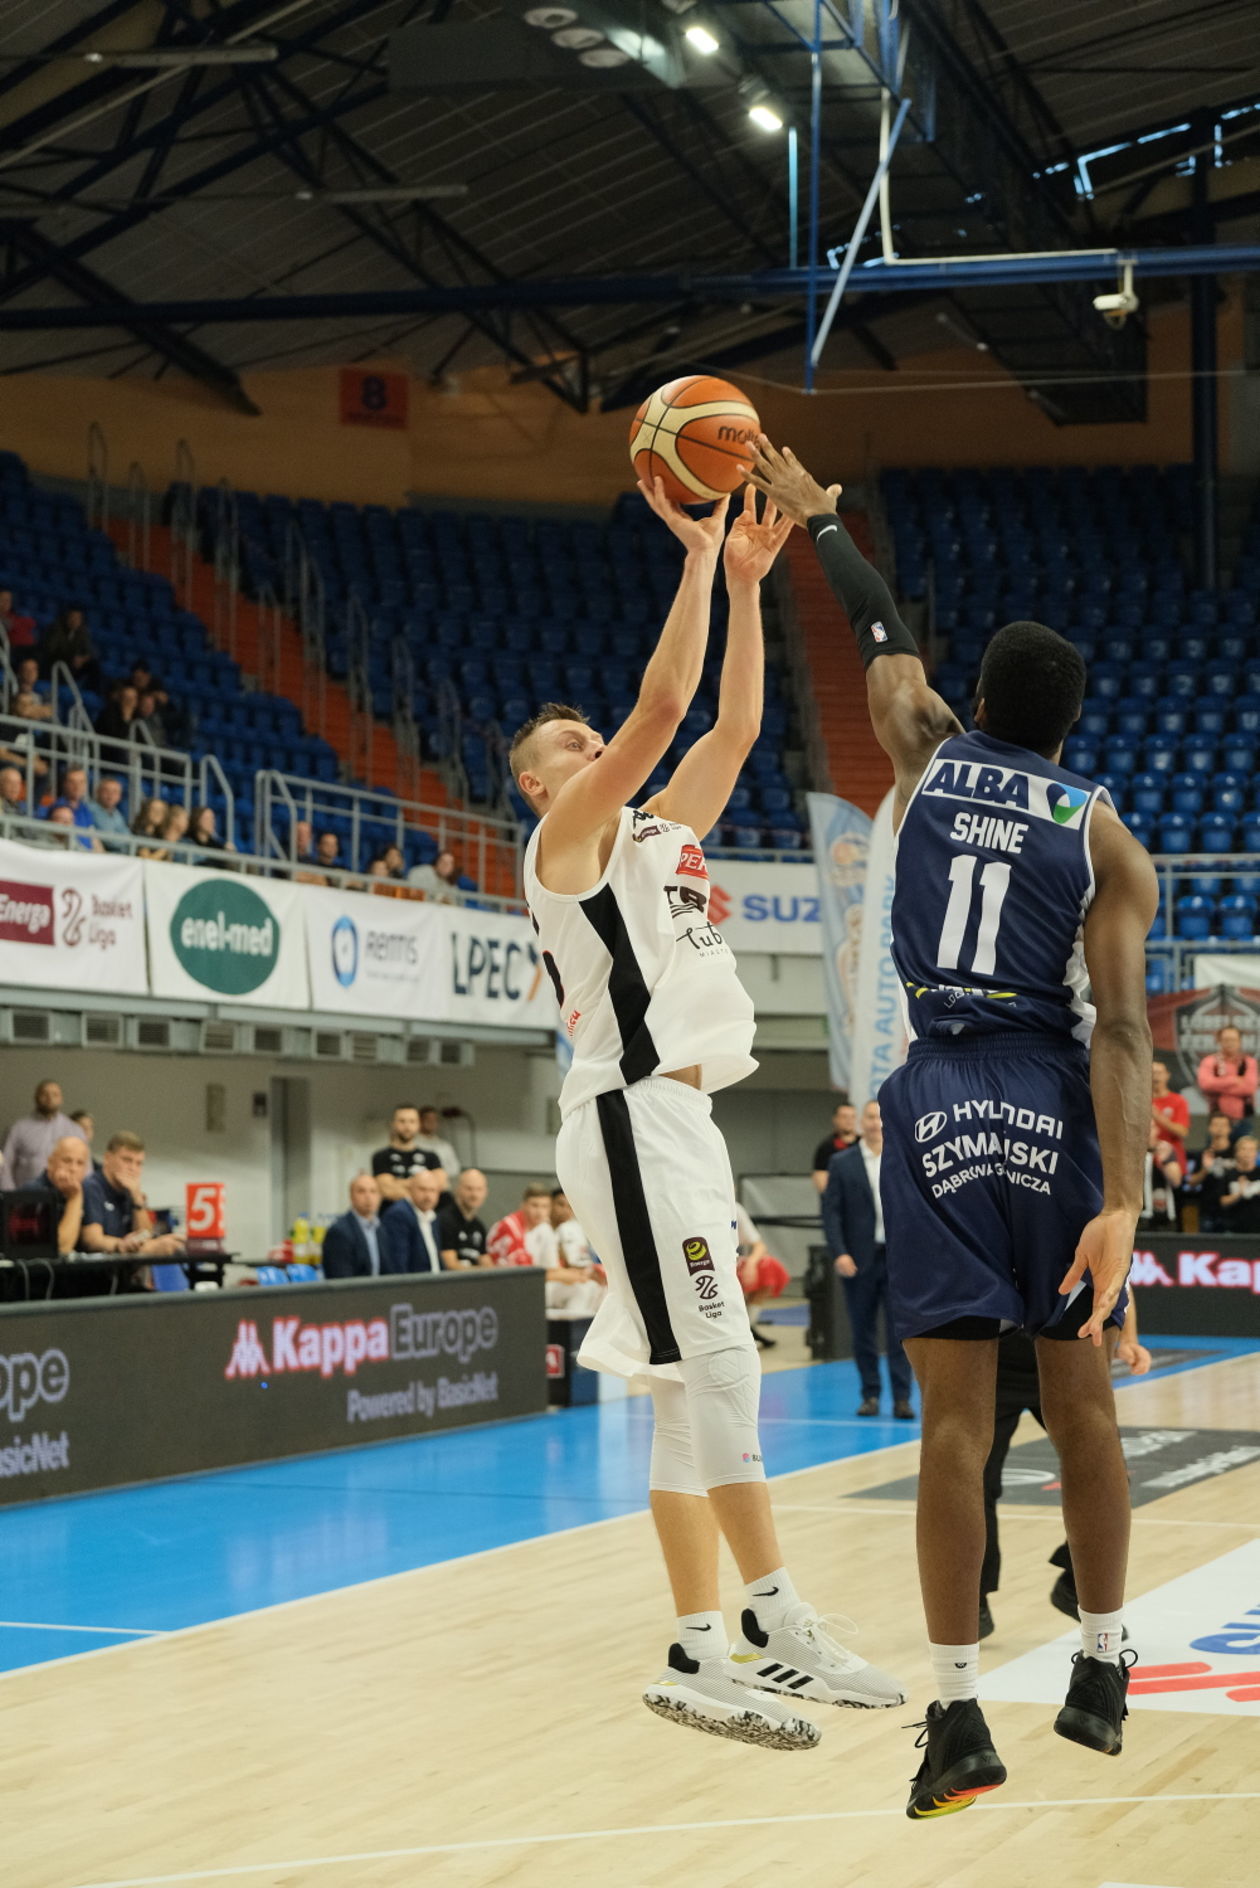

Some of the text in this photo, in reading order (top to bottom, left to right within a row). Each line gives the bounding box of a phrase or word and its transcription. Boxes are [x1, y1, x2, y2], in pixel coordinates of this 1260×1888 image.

[362, 375, 387, 410] 8
[924, 762, 1029, 810] ALBA
[950, 812, 1029, 854] SHINE
[181, 911, 273, 957] enel-med
[937, 854, 1011, 976] 11
[875, 956, 898, 1036] AUTO
[190, 1187, 217, 1232] 5
[698, 1301, 725, 1312] Basket
[272, 1303, 498, 1379] Kappa Europe
[347, 1388, 416, 1423] Powered
[417, 1379, 435, 1419] by
